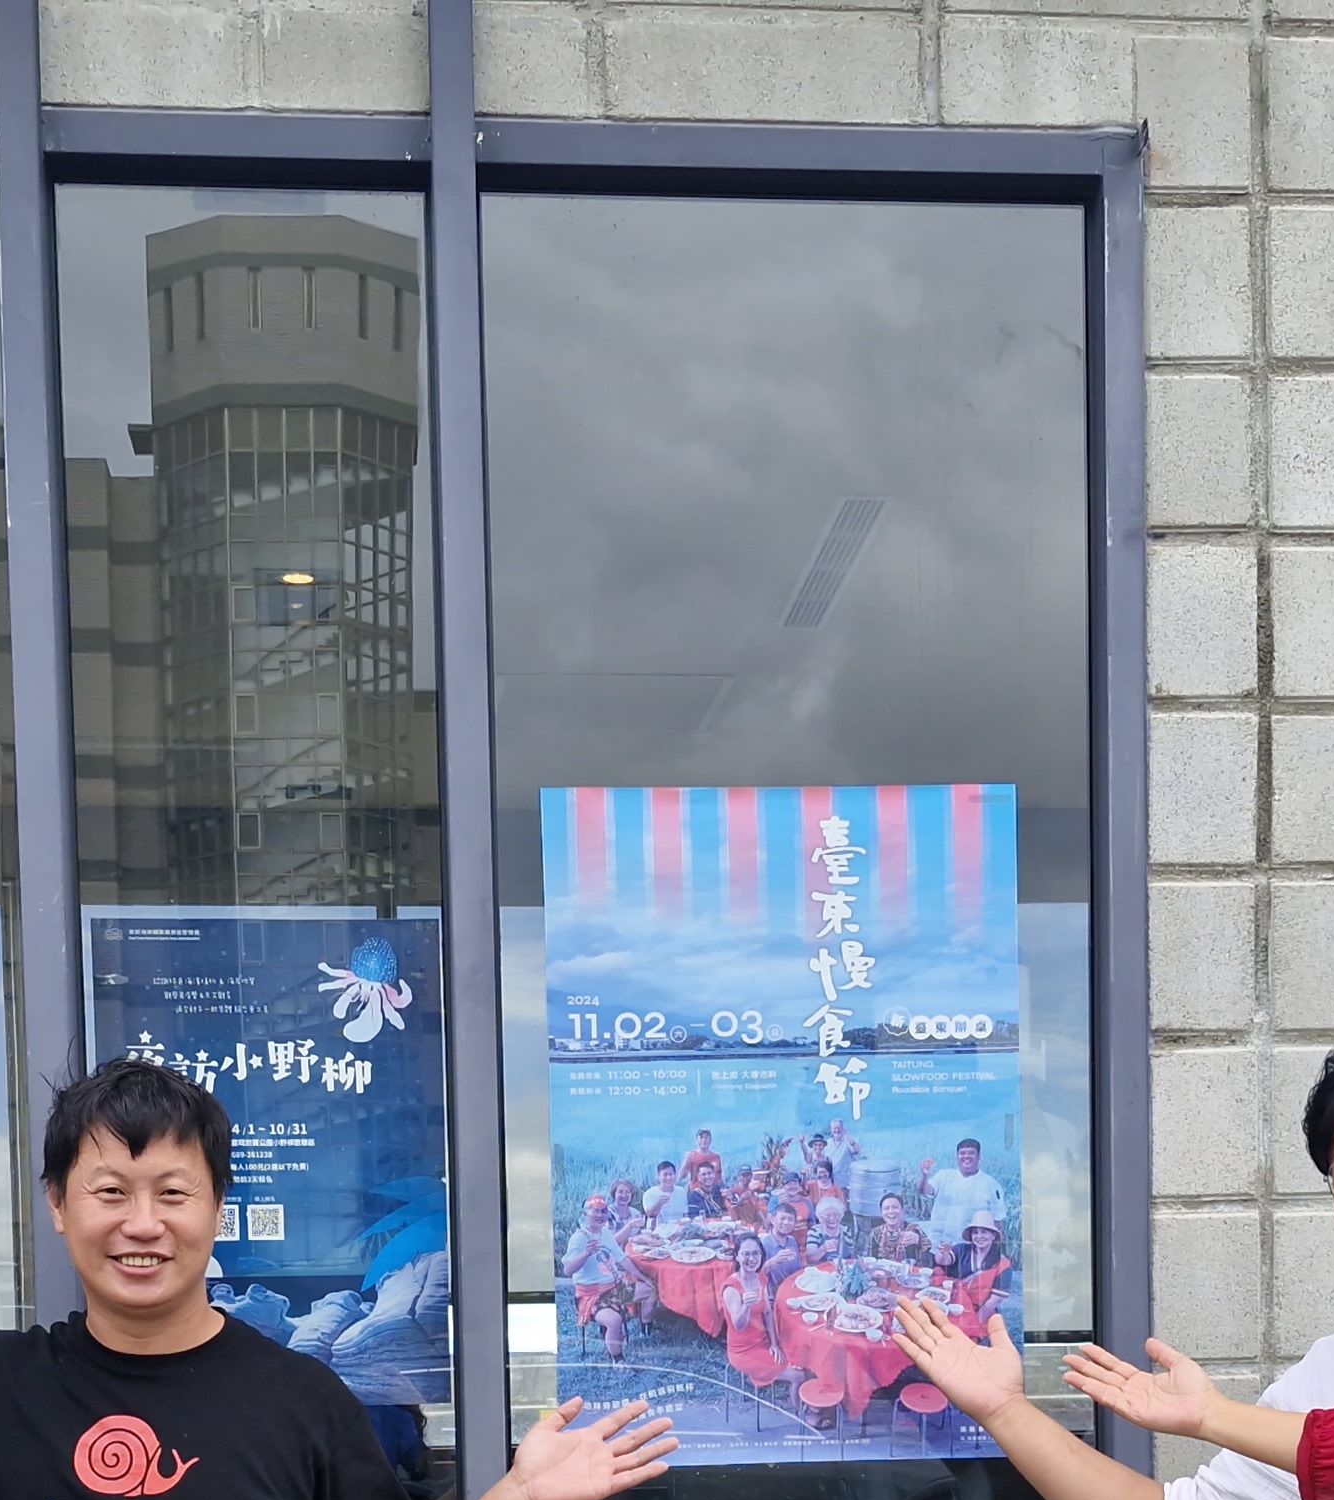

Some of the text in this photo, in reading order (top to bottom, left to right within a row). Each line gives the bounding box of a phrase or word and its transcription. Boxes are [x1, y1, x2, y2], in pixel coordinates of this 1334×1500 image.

[802, 815, 876, 1121] 臺東慢食節
[567, 996, 600, 1007] 2024
[891, 1060, 934, 1069] TAITUNG
[607, 1070, 641, 1080] 11:00
[652, 1068, 687, 1080] 16:00
[891, 1071, 997, 1082] SLOWFOOD FESTIVAL
[607, 1086, 642, 1096] 12:00
[652, 1085, 688, 1097] 14:00
[269, 1123, 308, 1136] 10/31
